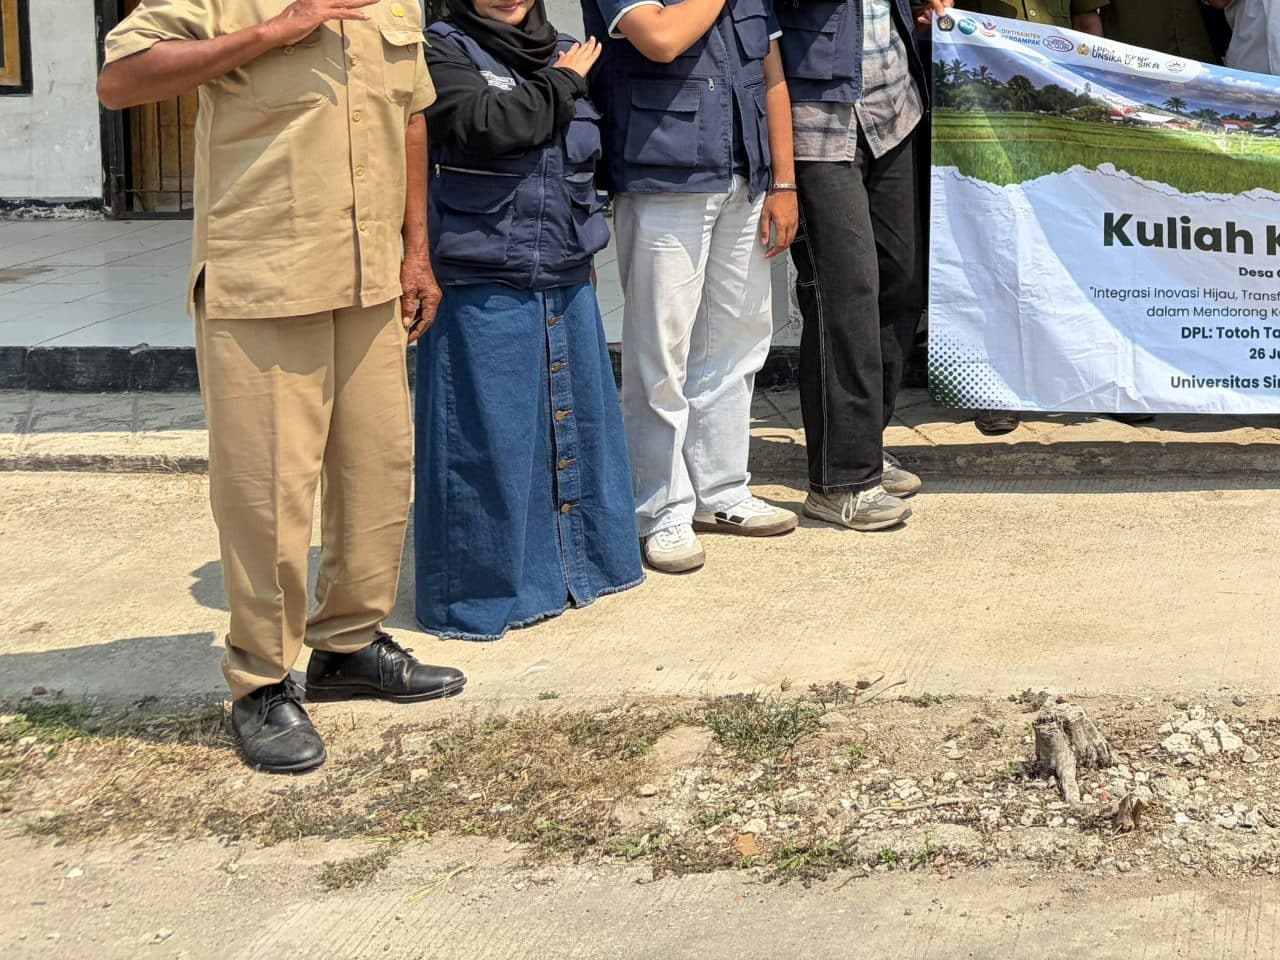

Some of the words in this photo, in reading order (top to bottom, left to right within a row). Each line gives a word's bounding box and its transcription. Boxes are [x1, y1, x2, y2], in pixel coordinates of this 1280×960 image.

[1103, 211, 1254, 255] Kuliah
[1239, 267, 1273, 279] Desa
[1090, 286, 1151, 302] "Integrasi
[1154, 287, 1200, 299] Inovasi
[1203, 288, 1238, 302] Hijau,
[1146, 306, 1190, 317] dalam
[1193, 306, 1268, 320] Mendorong
[1181, 327, 1213, 339] DPL:
[1216, 326, 1260, 339] Totoh
[1249, 348, 1266, 360] 26
[1170, 375, 1259, 389] Universitas
